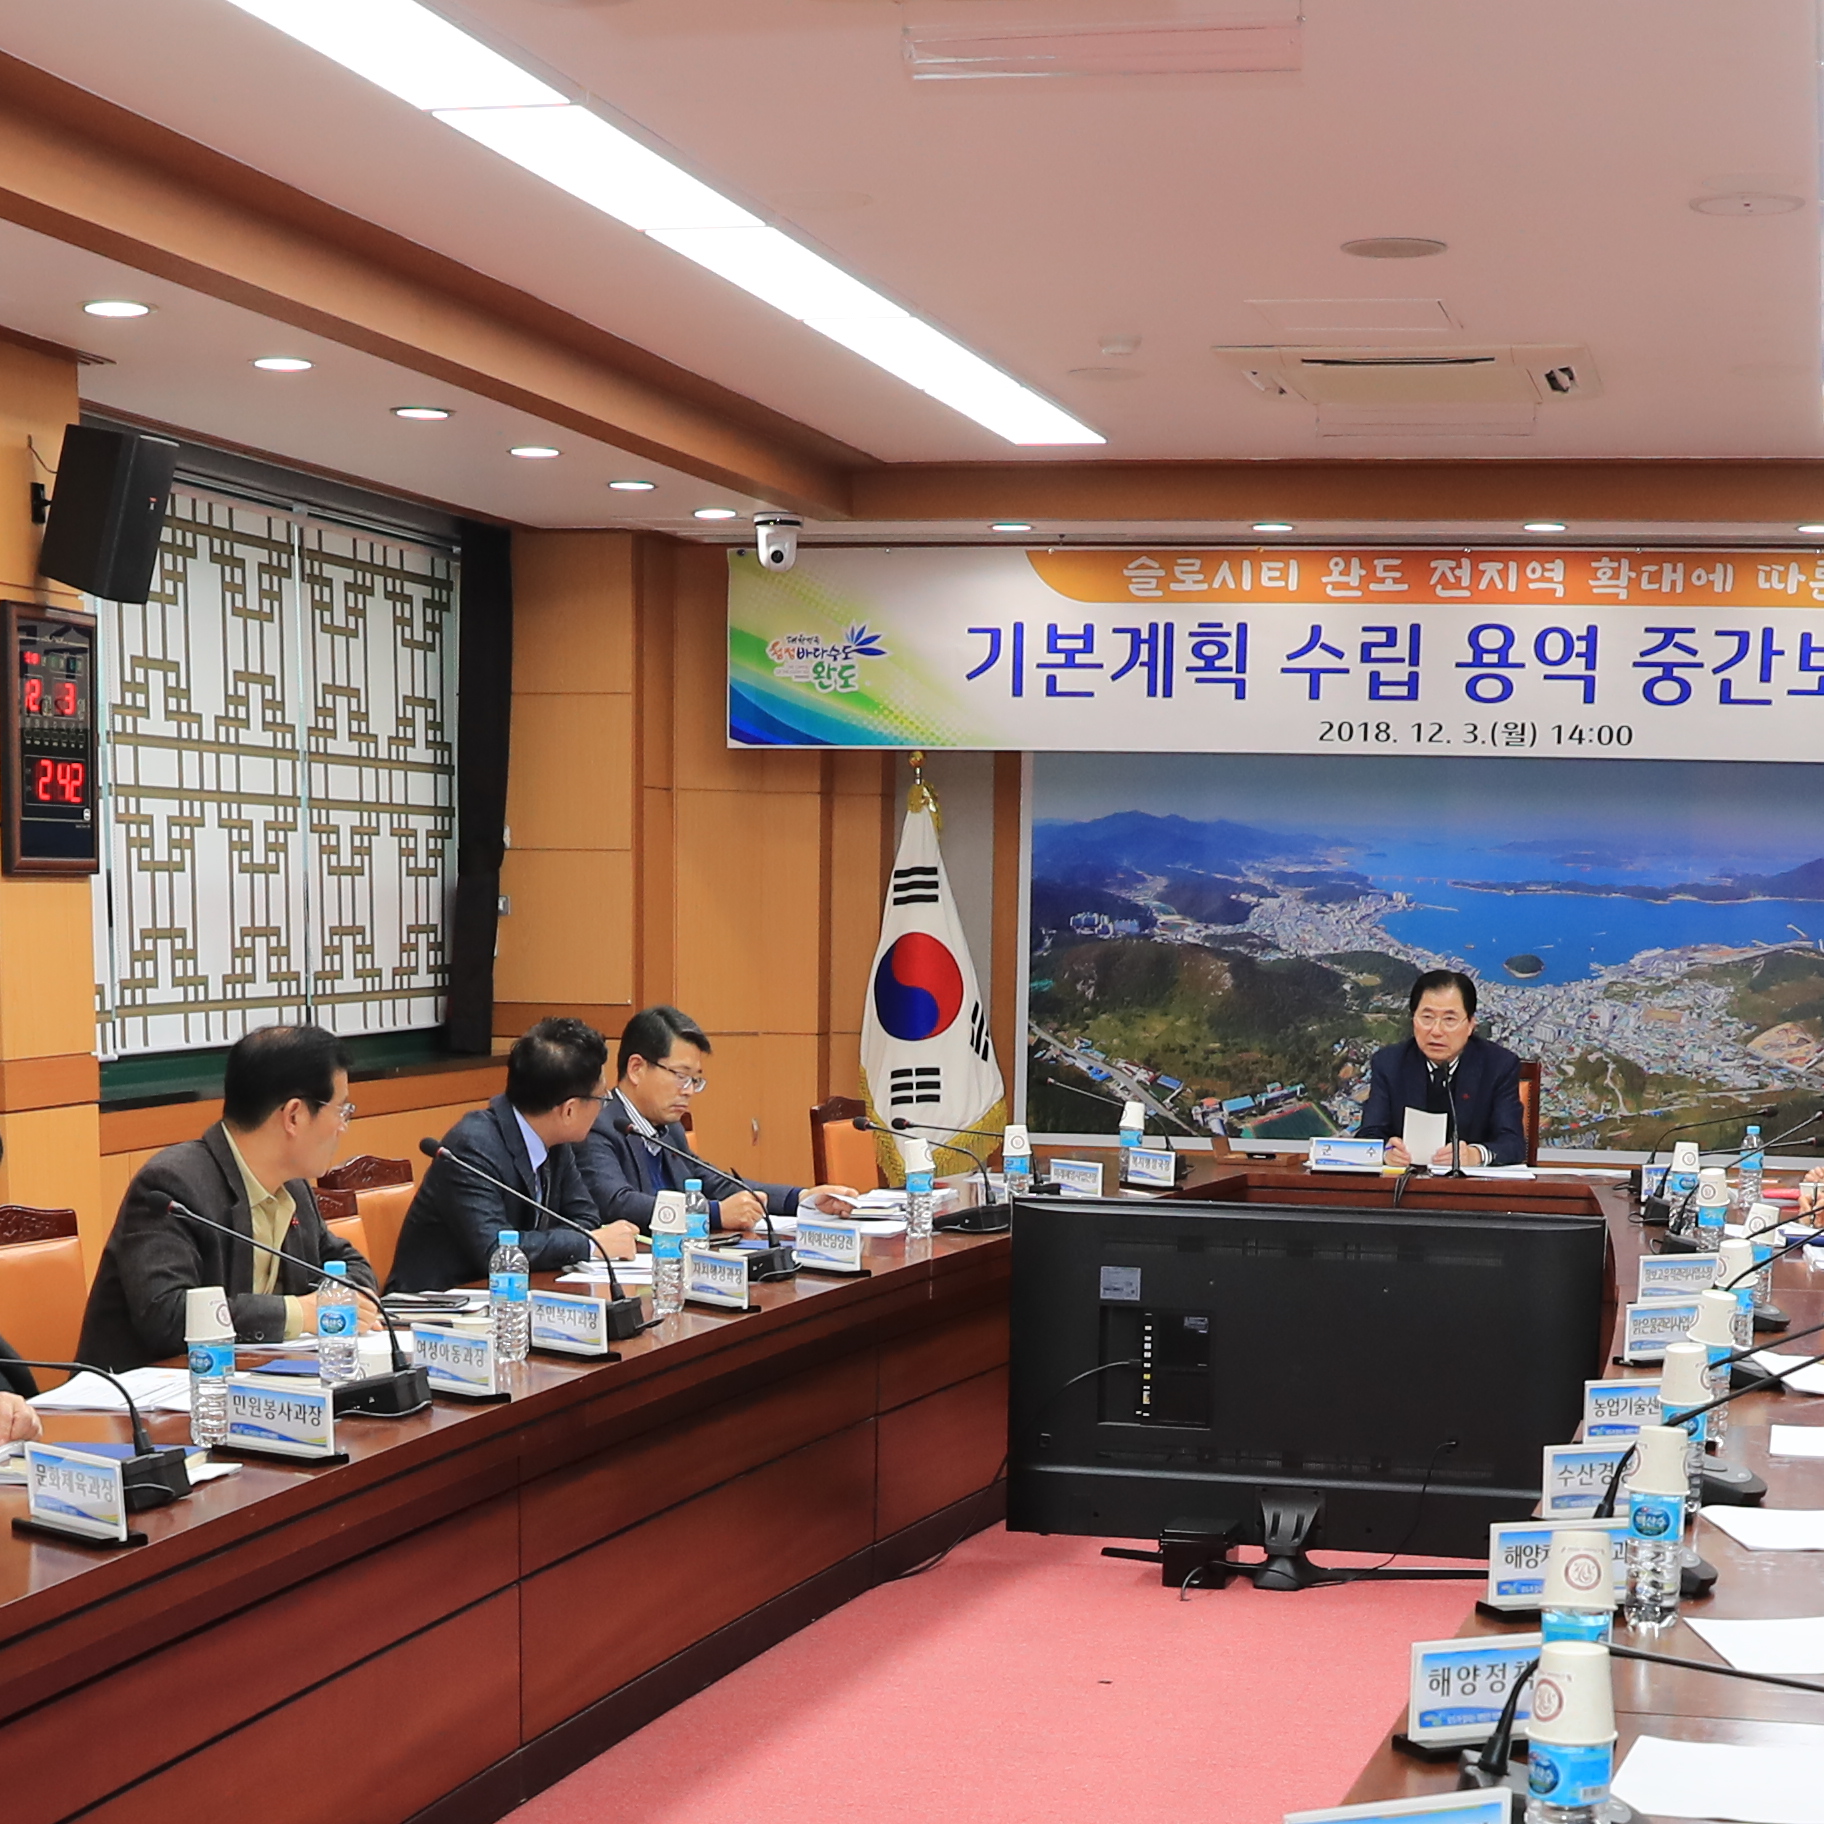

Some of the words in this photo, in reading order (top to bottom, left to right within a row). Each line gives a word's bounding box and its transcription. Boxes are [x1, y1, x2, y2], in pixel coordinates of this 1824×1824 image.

[1122, 554, 1299, 598] 슬로시티
[1320, 556, 1410, 598] 완도
[1428, 556, 1567, 598] 전지역
[1587, 555, 1736, 600] 확대에
[813, 661, 856, 690] 완도
[964, 620, 1249, 702] 기본계획
[1278, 622, 1423, 702] 수립
[1454, 622, 1600, 705] 용역
[1318, 720, 1399, 744] 2018.
[1410, 721, 1452, 745] 12.
[1462, 720, 1539, 748] 3.(월)
[1549, 723, 1634, 746] 14:00
[536, 1304, 598, 1330] 주민복지과장
[416, 1339, 486, 1368] 여성아동과장
[232, 1394, 323, 1427] 민원봉사과장
[35, 1463, 115, 1503] 문화체육과장
[1635, 1513, 1667, 1529] 백산수
